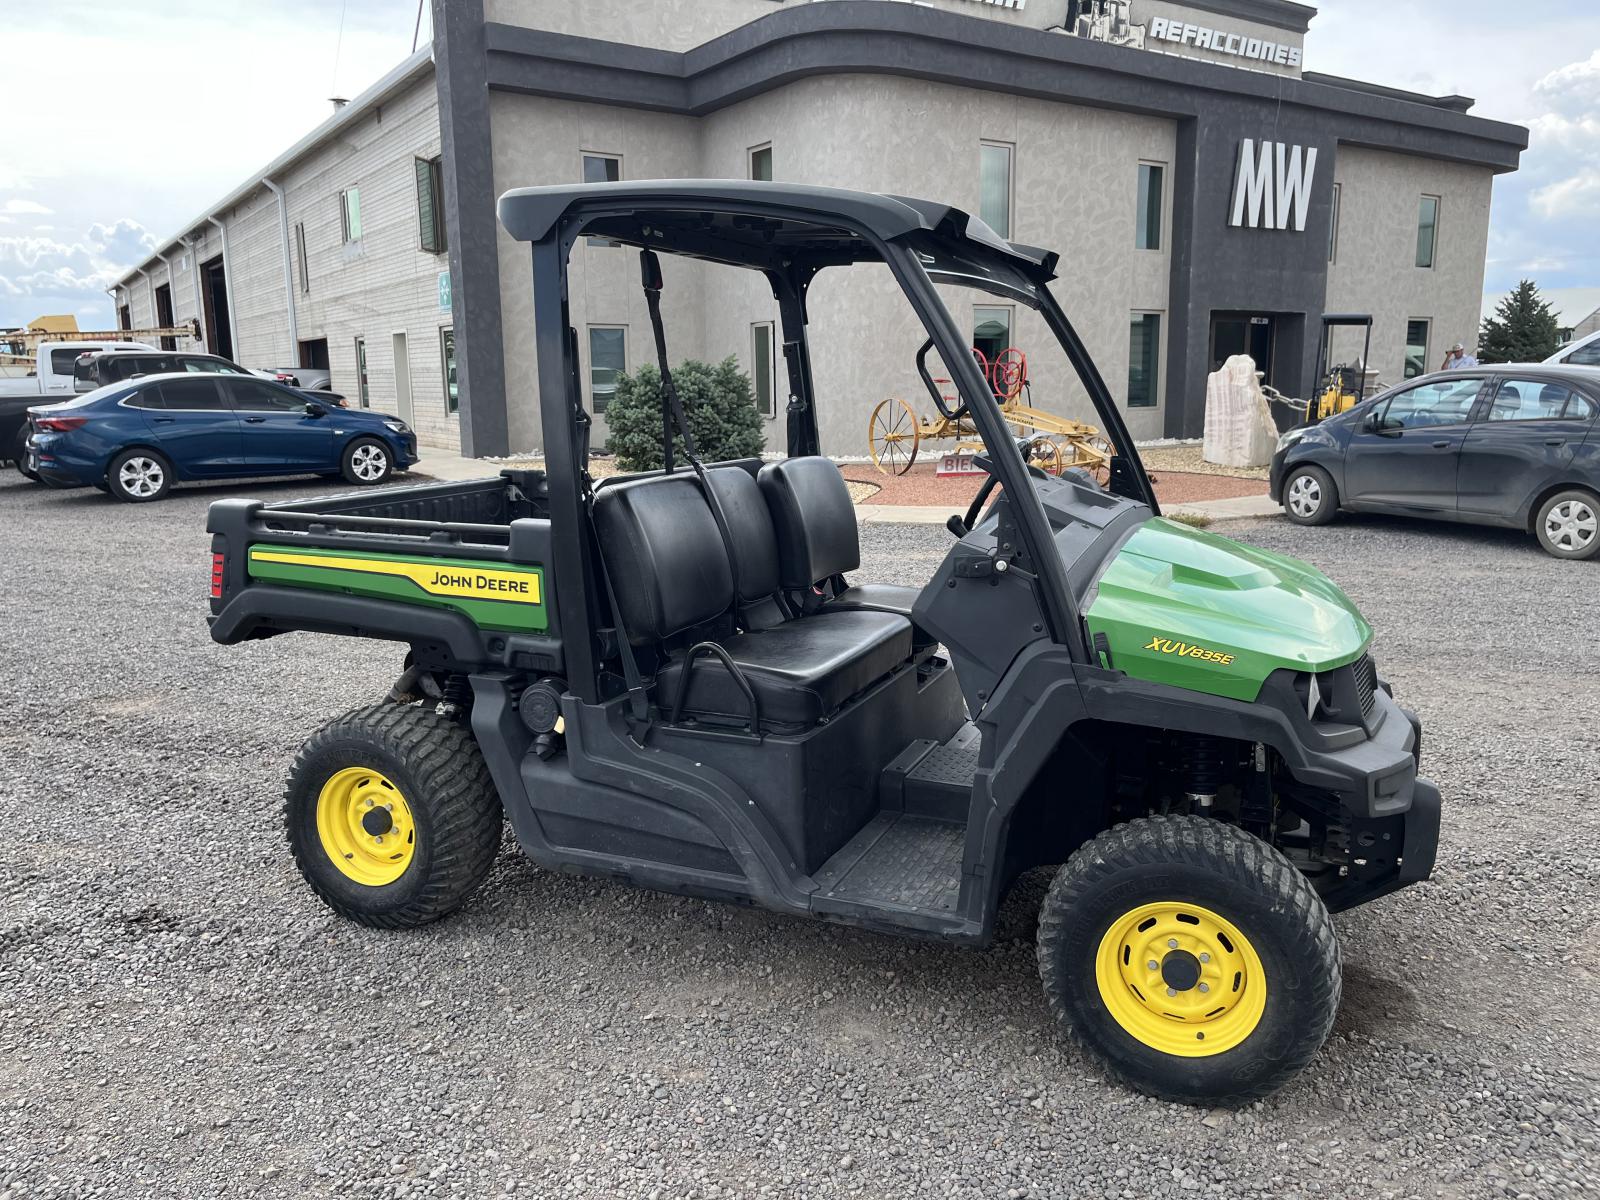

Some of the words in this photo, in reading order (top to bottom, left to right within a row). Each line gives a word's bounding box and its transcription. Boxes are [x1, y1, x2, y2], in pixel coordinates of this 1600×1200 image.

[1150, 16, 1303, 67] REFACCIONES
[1230, 138, 1318, 231] MW
[431, 572, 472, 588] JOHN
[476, 576, 529, 593] DEERE
[1143, 637, 1235, 665] XUV835E
